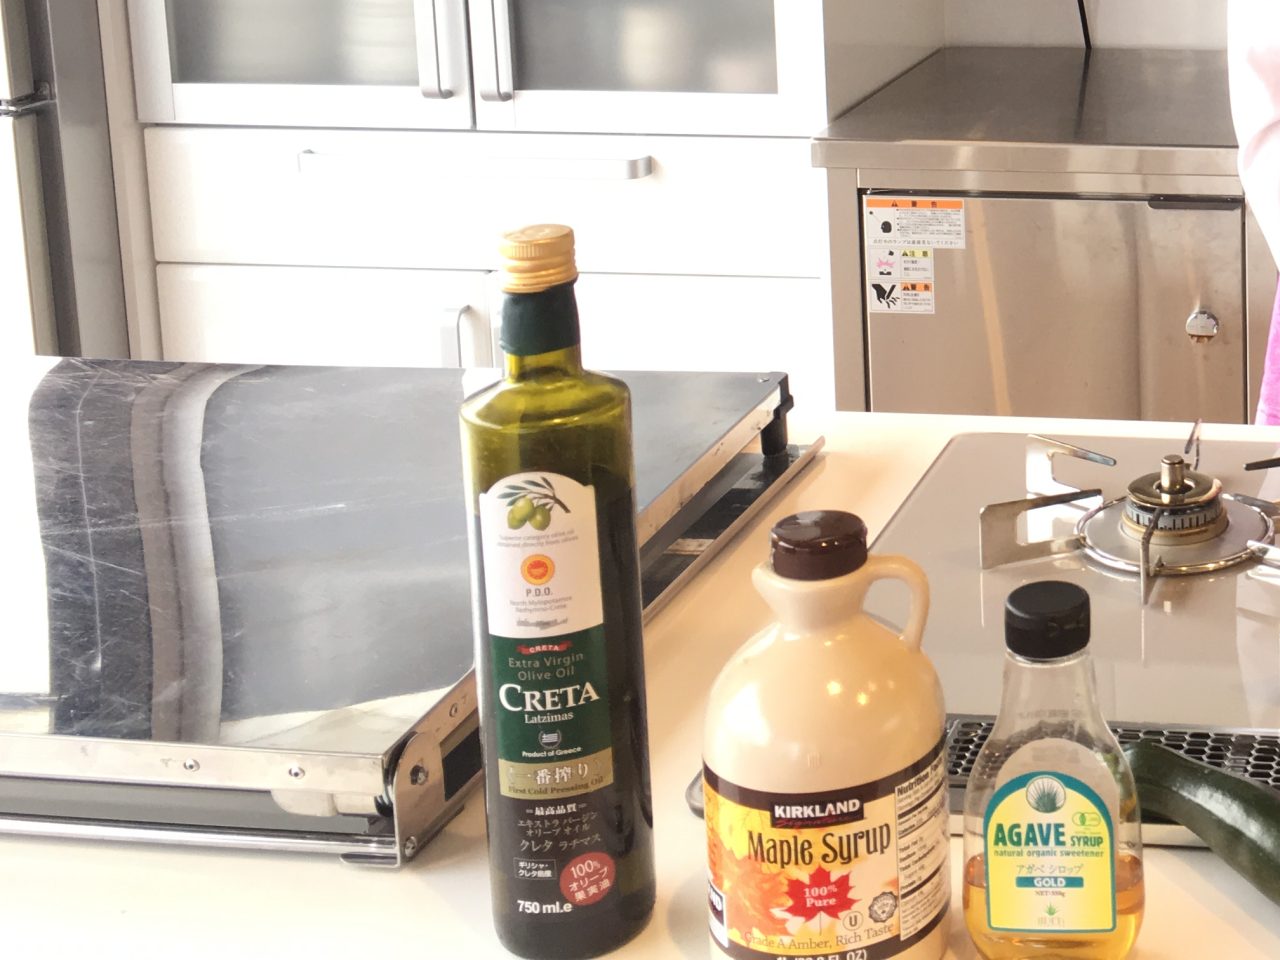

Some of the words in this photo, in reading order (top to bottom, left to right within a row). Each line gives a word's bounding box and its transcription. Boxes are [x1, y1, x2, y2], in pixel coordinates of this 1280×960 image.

[525, 587, 553, 597] P.D.O.
[529, 644, 560, 654] CRETA
[508, 657, 540, 669] Extra
[544, 652, 584, 667] Virgin
[518, 670, 552, 681] Olive
[555, 666, 575, 679] Oil
[498, 681, 600, 712] CRETA
[524, 711, 574, 724] Latzimas
[522, 750, 547, 758] Product
[556, 746, 582, 756] Greece
[774, 798, 860, 819] KIRKLAND
[993, 823, 1066, 847] AGAVE
[1070, 835, 1104, 848] SYRUP
[520, 839, 553, 853] クレタ
[747, 830, 814, 869] Maple
[821, 823, 891, 865] Syrup
[994, 849, 1024, 857] natural
[1027, 849, 1057, 858] organic
[1060, 849, 1104, 857] sweetener
[570, 860, 601, 879] 100%
[1033, 877, 1067, 887] GOLD
[803, 884, 838, 898] 100%
[517, 900, 541, 913] 750
[805, 897, 837, 908] Pure
[836, 934, 862, 948] Rich
[864, 923, 894, 940] Taste
